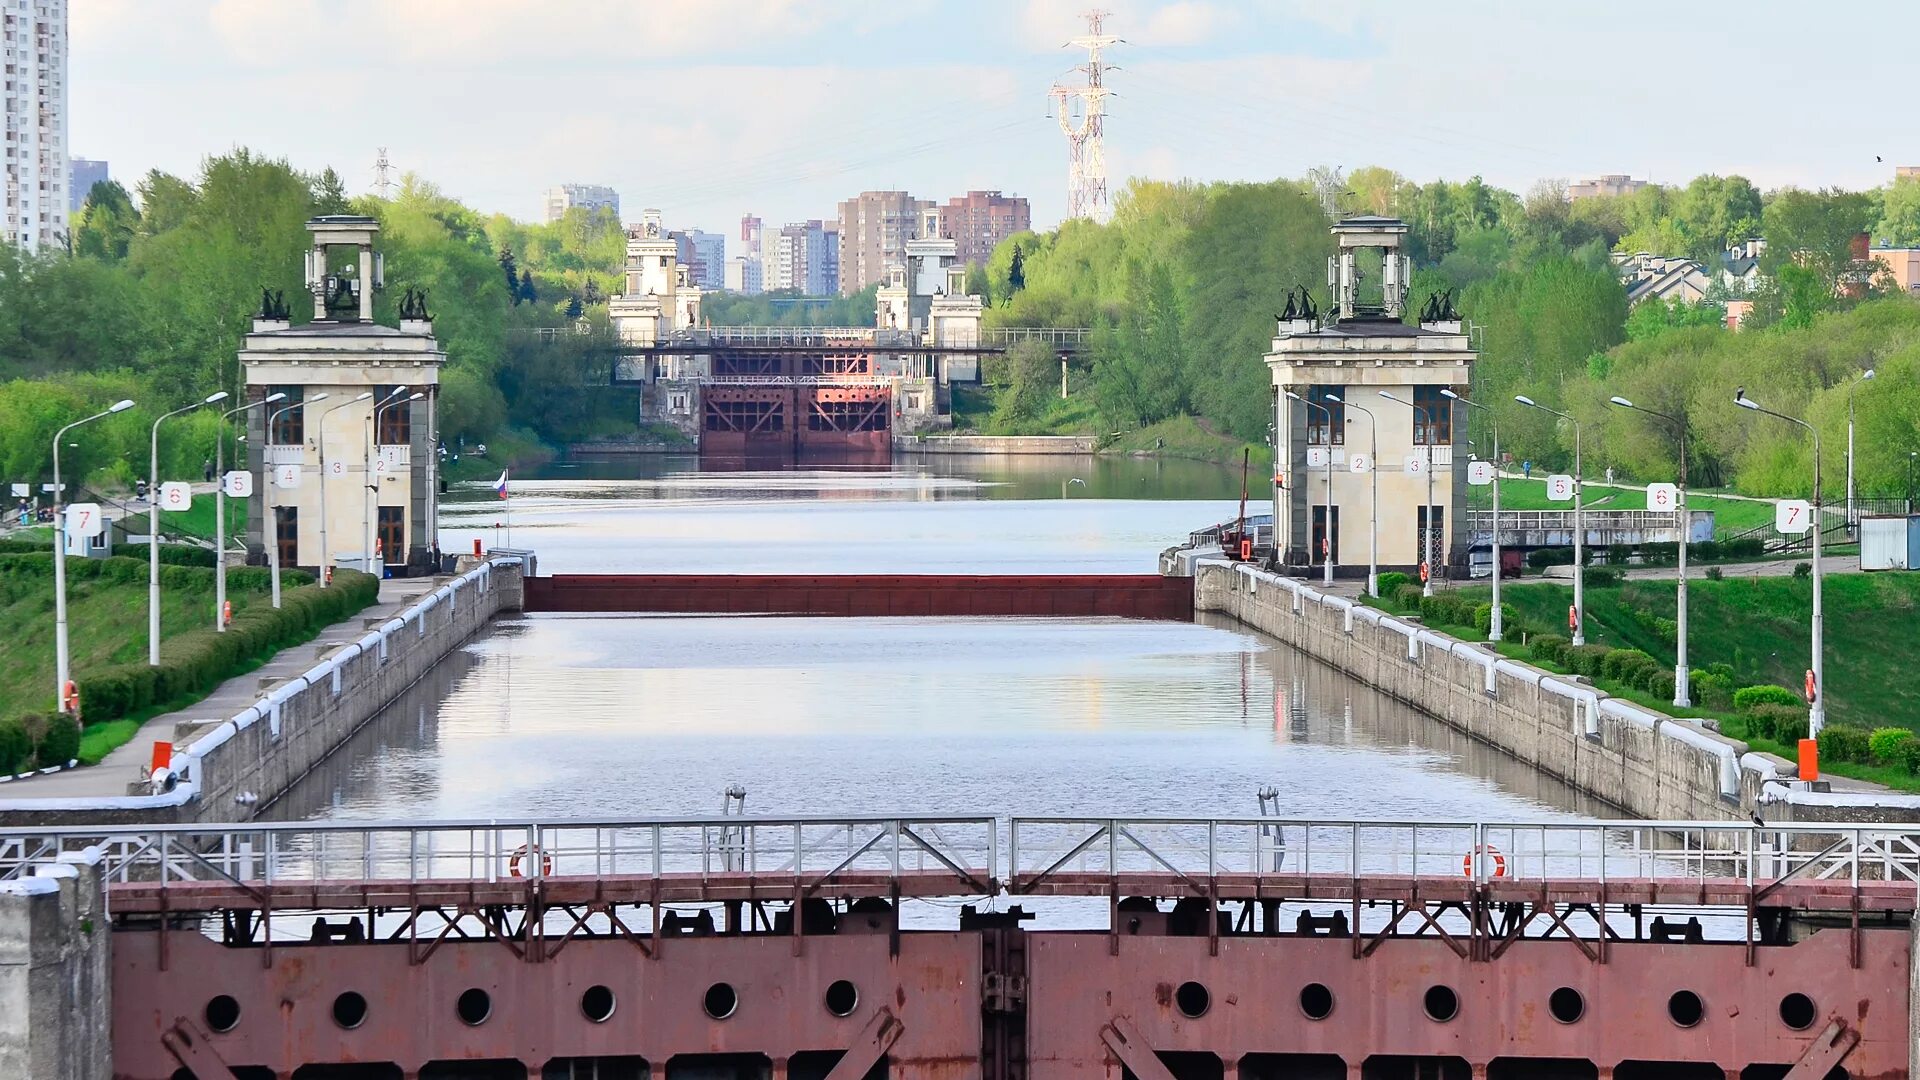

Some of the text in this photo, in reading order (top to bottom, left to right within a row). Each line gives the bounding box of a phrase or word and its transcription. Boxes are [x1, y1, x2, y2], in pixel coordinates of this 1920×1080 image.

[334, 462, 341, 473] 3
[377, 460, 384, 471] 2
[1356, 458, 1363, 468] 2
[1411, 461, 1419, 471] 3
[285, 470, 293, 482] 4
[1475, 466, 1483, 478] 4
[235, 477, 243, 491] 5
[1556, 480, 1565, 494] 5
[170, 488, 181, 503] 6
[1657, 490, 1667, 504] 6
[79, 511, 90, 528] 7
[1788, 507, 1800, 525] 7
